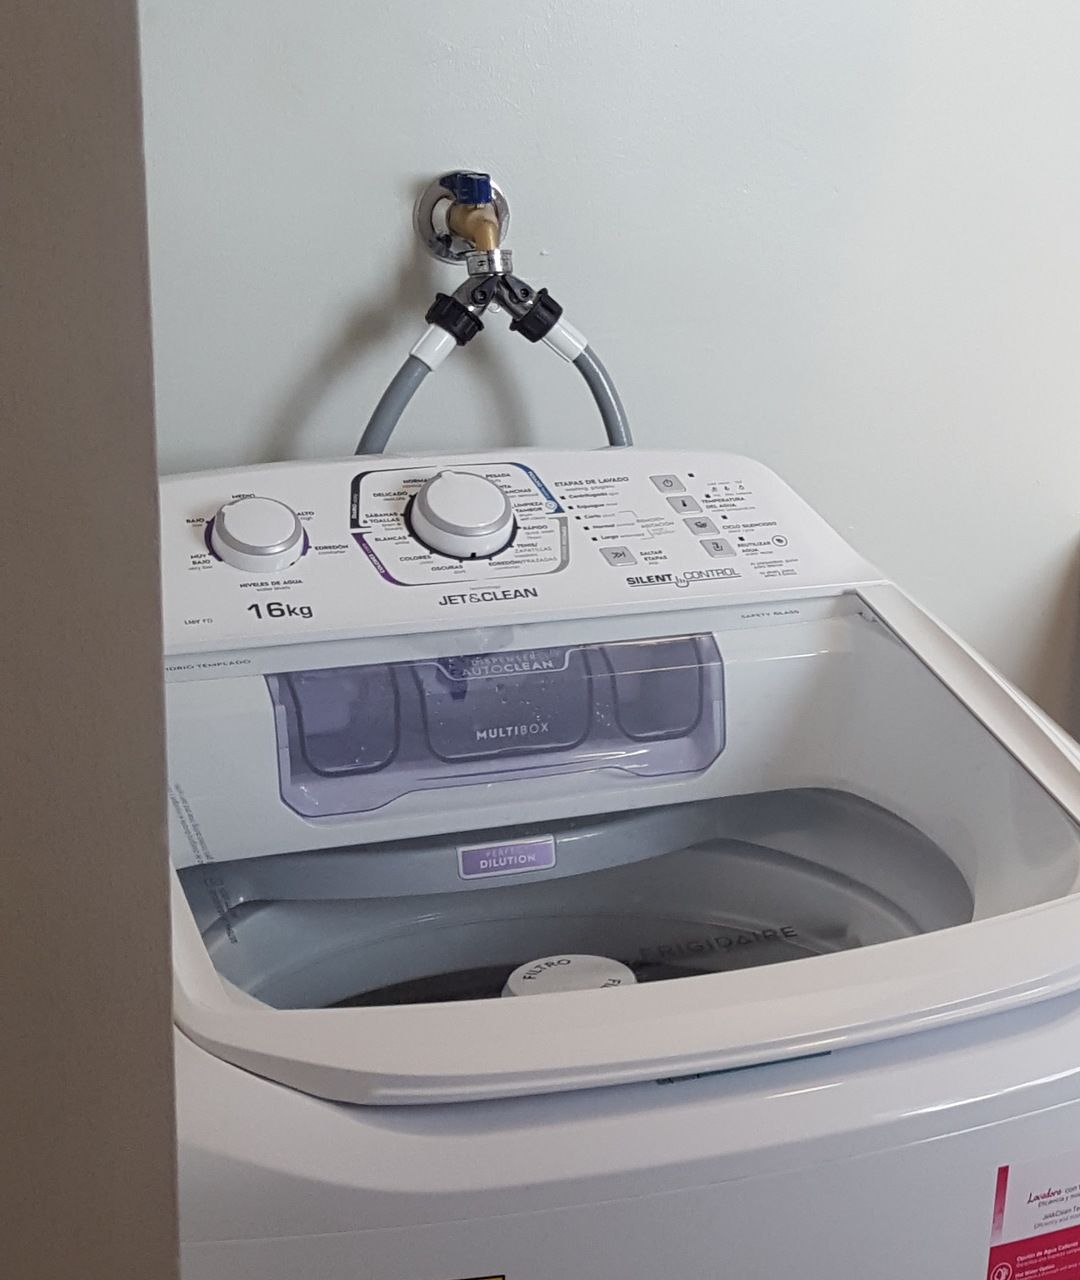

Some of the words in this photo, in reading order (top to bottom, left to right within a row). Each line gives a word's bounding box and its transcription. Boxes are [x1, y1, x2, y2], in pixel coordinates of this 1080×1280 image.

[626, 573, 673, 585] SILENT
[682, 567, 740, 580] CONTROL
[438, 587, 538, 607] JET&CLEAN
[247, 601, 314, 620] 16kg
[462, 660, 554, 677] AUTOCLEAN
[476, 722, 550, 741] MULTIBOX
[479, 853, 537, 870] DILUTION
[640, 925, 799, 960] FRIGIDAIRE
[522, 959, 572, 981] FILTRO
